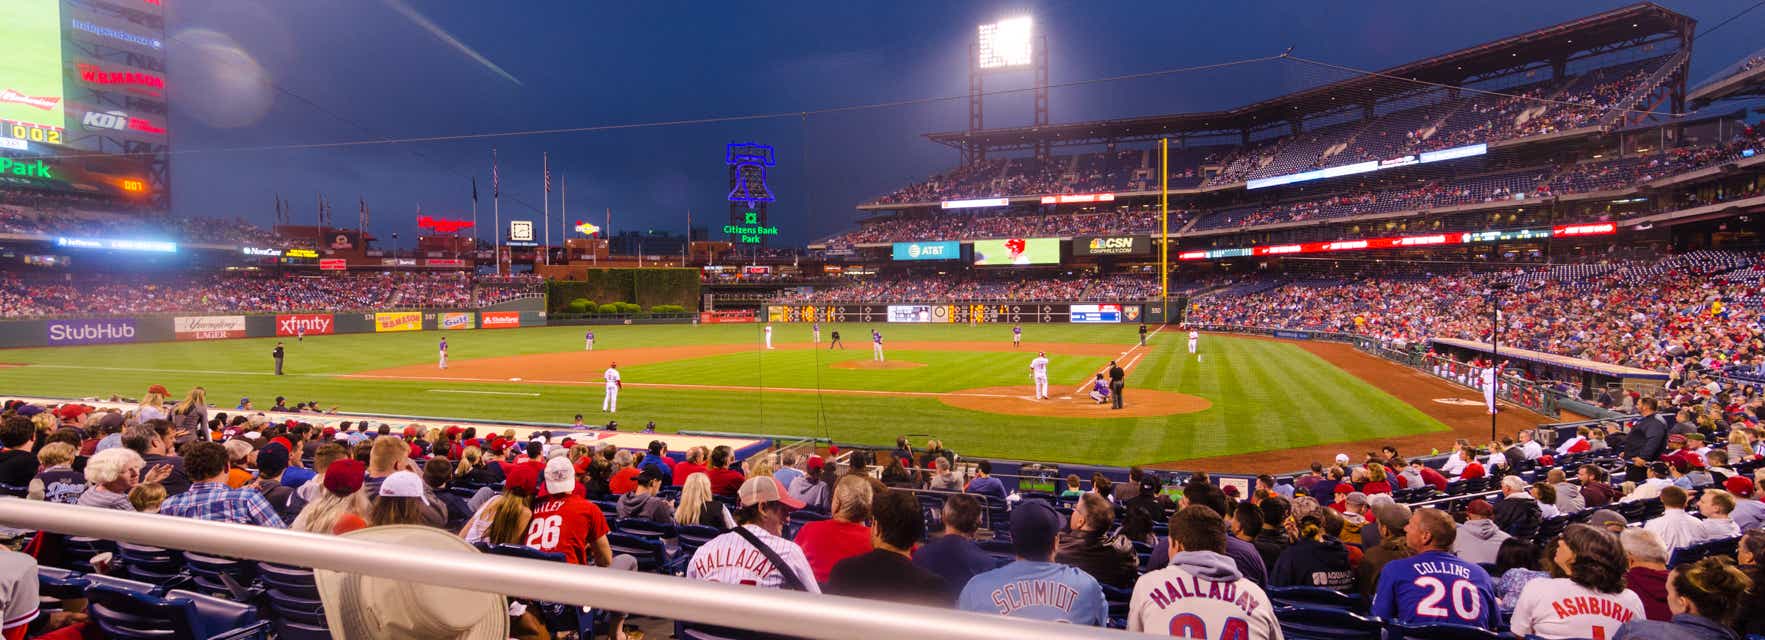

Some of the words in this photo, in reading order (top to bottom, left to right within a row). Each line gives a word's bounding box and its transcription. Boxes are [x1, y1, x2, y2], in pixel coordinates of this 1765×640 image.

[0, 157, 52, 178] Park
[723, 225, 757, 234] Citizens
[757, 226, 779, 236] Bank
[742, 234, 761, 243] Park
[921, 245, 944, 256] AT&T
[1106, 238, 1134, 248] CSN
[49, 323, 135, 341] StubHub
[281, 315, 330, 335] xfinity
[526, 515, 563, 550] 26
[695, 547, 775, 579] HALLADAY
[1413, 562, 1471, 579] COLLINS
[991, 579, 1079, 616] SCHMIDT
[1149, 576, 1259, 616] HALLADAY
[1414, 576, 1481, 621] 20
[1552, 597, 1633, 624] ASHBURN
